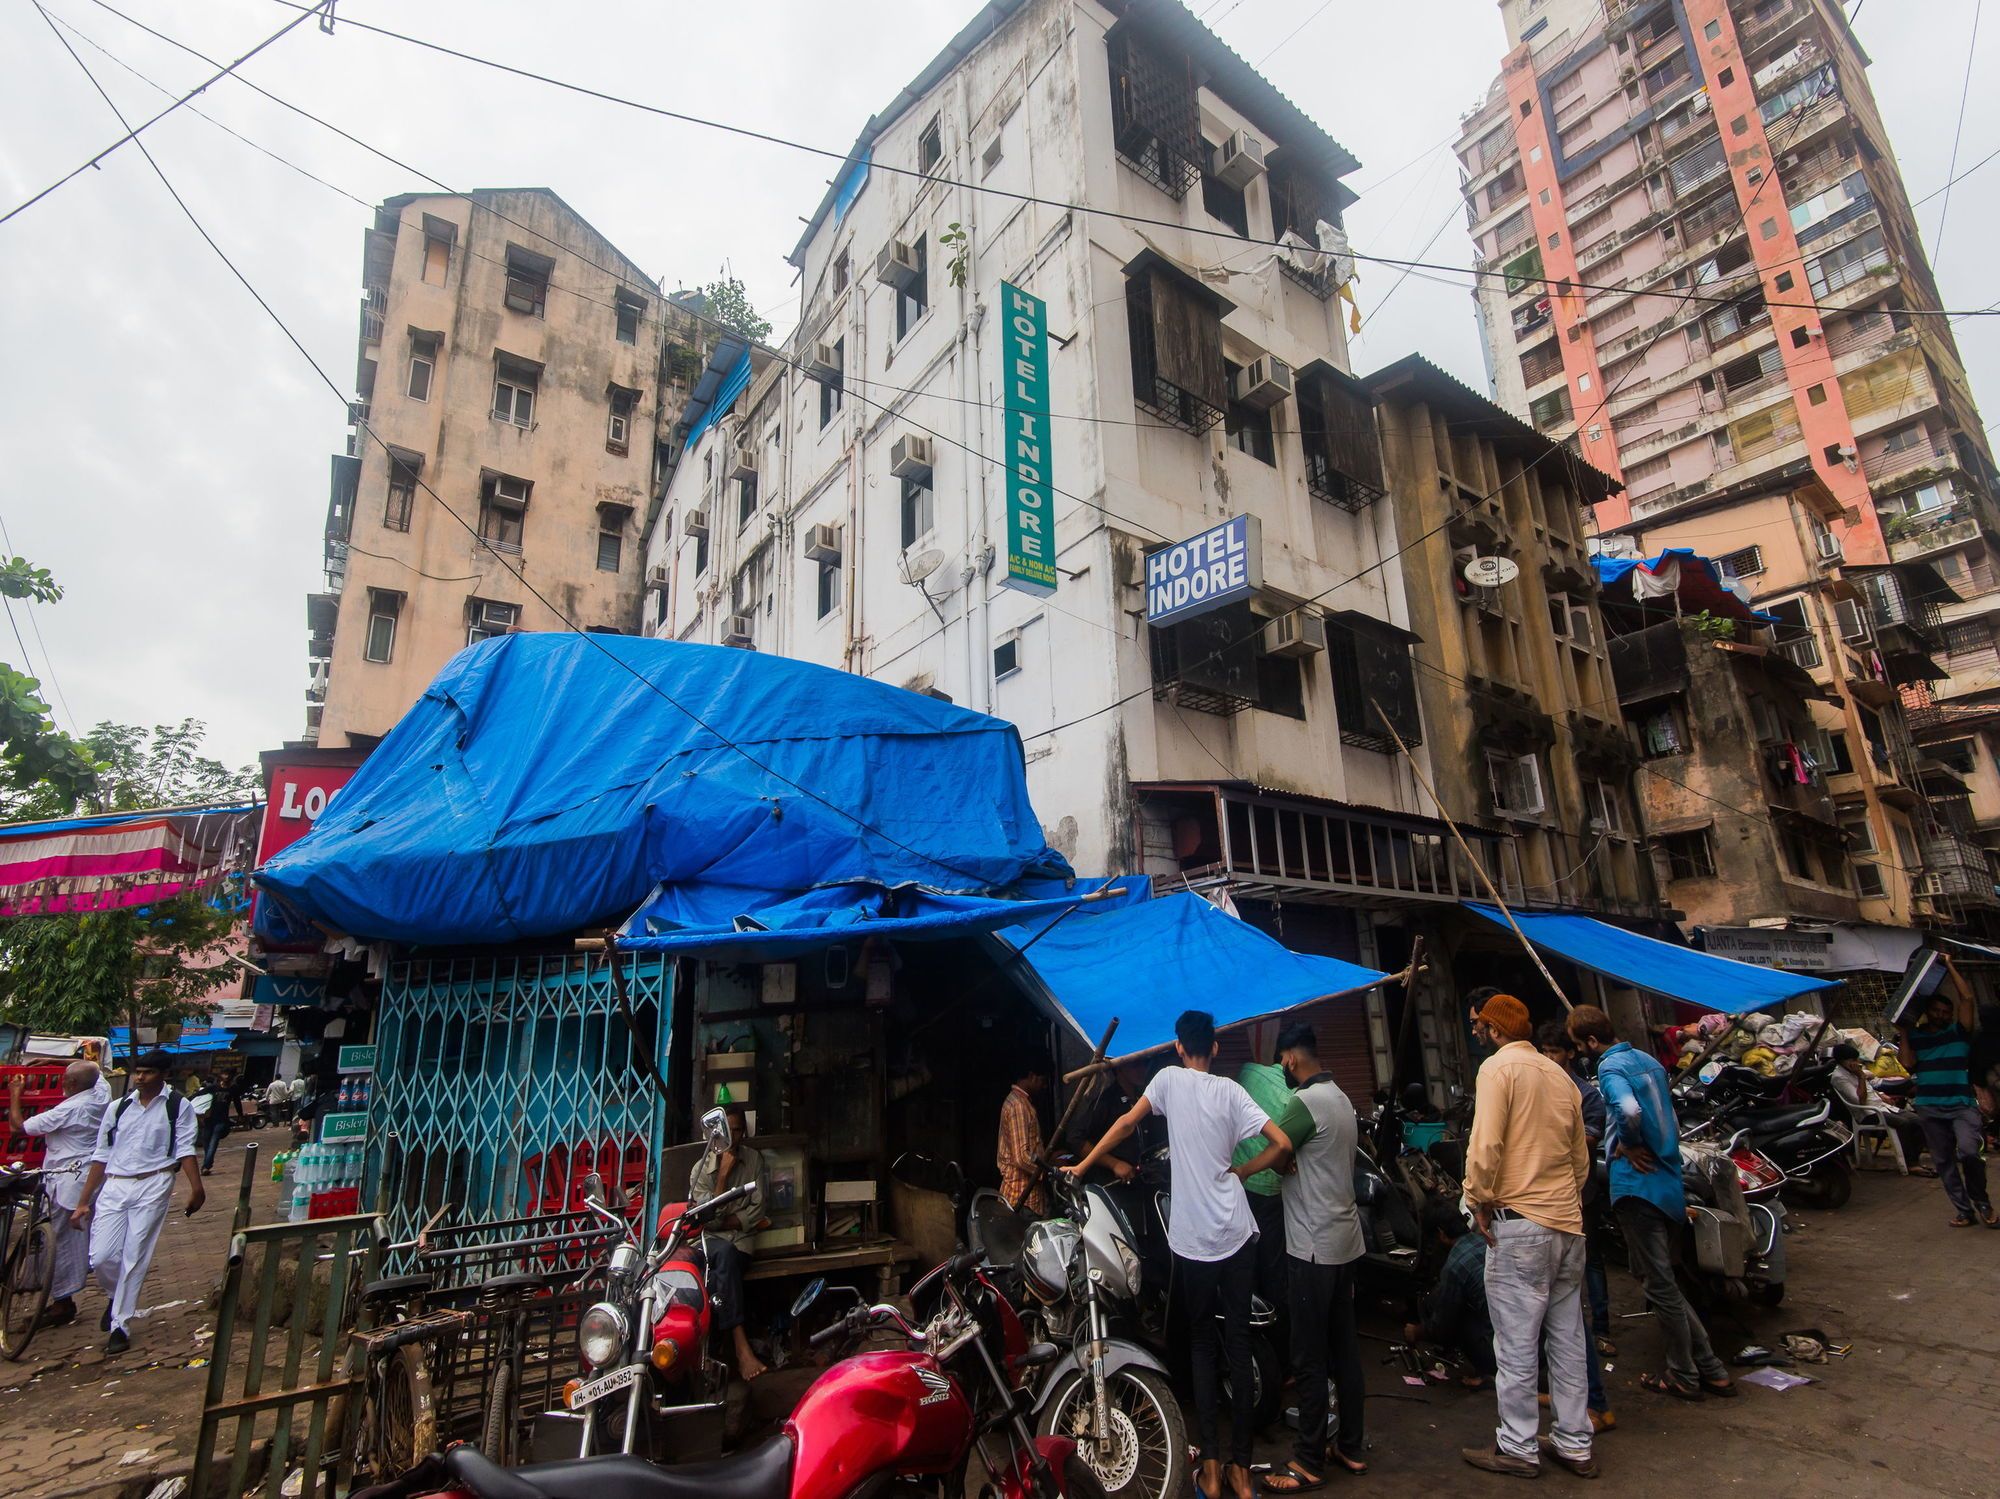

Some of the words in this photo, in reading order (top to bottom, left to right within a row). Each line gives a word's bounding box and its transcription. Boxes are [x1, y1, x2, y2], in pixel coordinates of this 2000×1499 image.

[1013, 293, 1036, 403] HOTEL
[1018, 411, 1042, 558] INDORE
[1150, 523, 1245, 586] HOTEL
[1150, 552, 1245, 618] INDORE
[279, 782, 342, 821] LO
[272, 980, 327, 998] viv
[351, 1050, 375, 1062] Bisle
